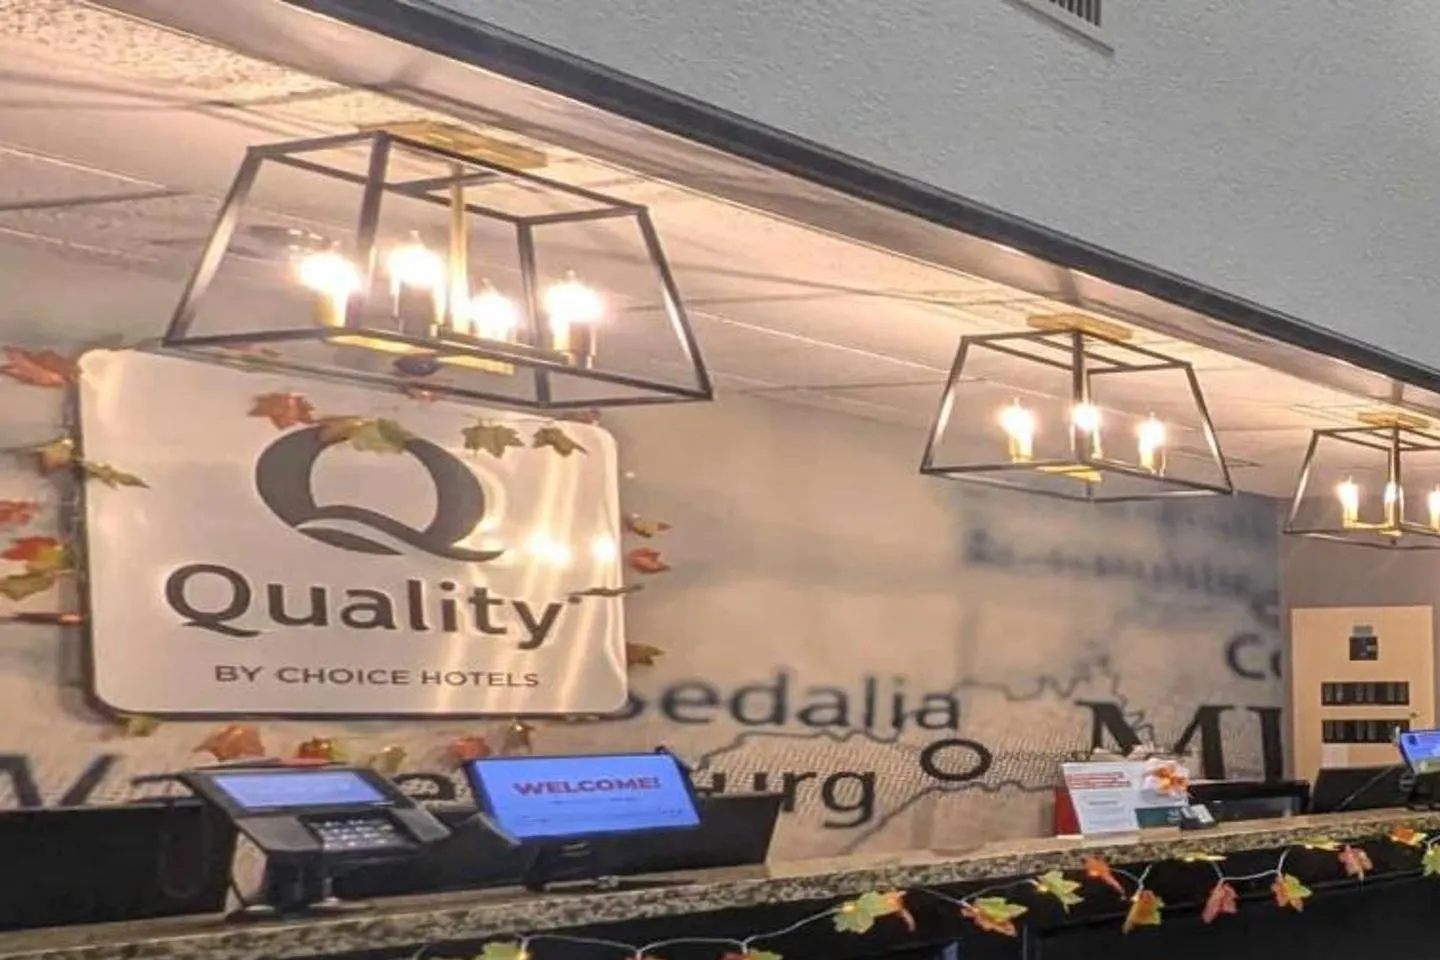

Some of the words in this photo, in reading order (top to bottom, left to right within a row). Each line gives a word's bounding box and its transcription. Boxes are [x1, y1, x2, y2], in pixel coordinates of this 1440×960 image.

[165, 563, 565, 649] Quality
[214, 665, 262, 683] BY
[275, 666, 410, 685] CHOICE
[421, 670, 539, 687] HOTELS
[625, 670, 961, 732] edalia
[514, 776, 661, 795] WELCOME!
